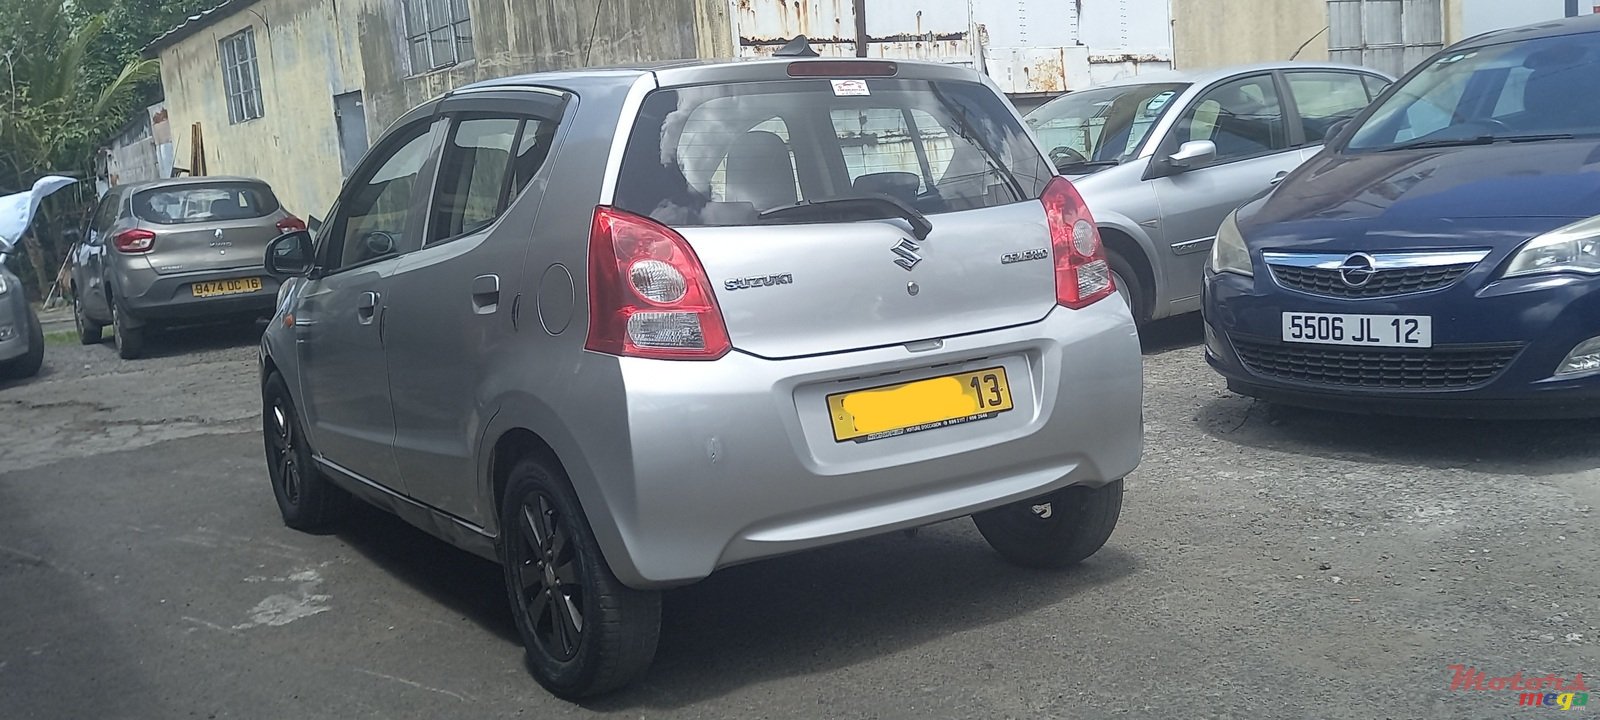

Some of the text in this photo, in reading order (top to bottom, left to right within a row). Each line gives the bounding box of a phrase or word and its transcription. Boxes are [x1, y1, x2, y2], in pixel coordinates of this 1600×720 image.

[195, 281, 223, 294] 9474
[227, 281, 241, 291] DC
[247, 279, 259, 289] 16
[724, 273, 793, 291] SUZUKI
[1291, 315, 1419, 343] 5506 JL 12
[970, 374, 1002, 409] 13
